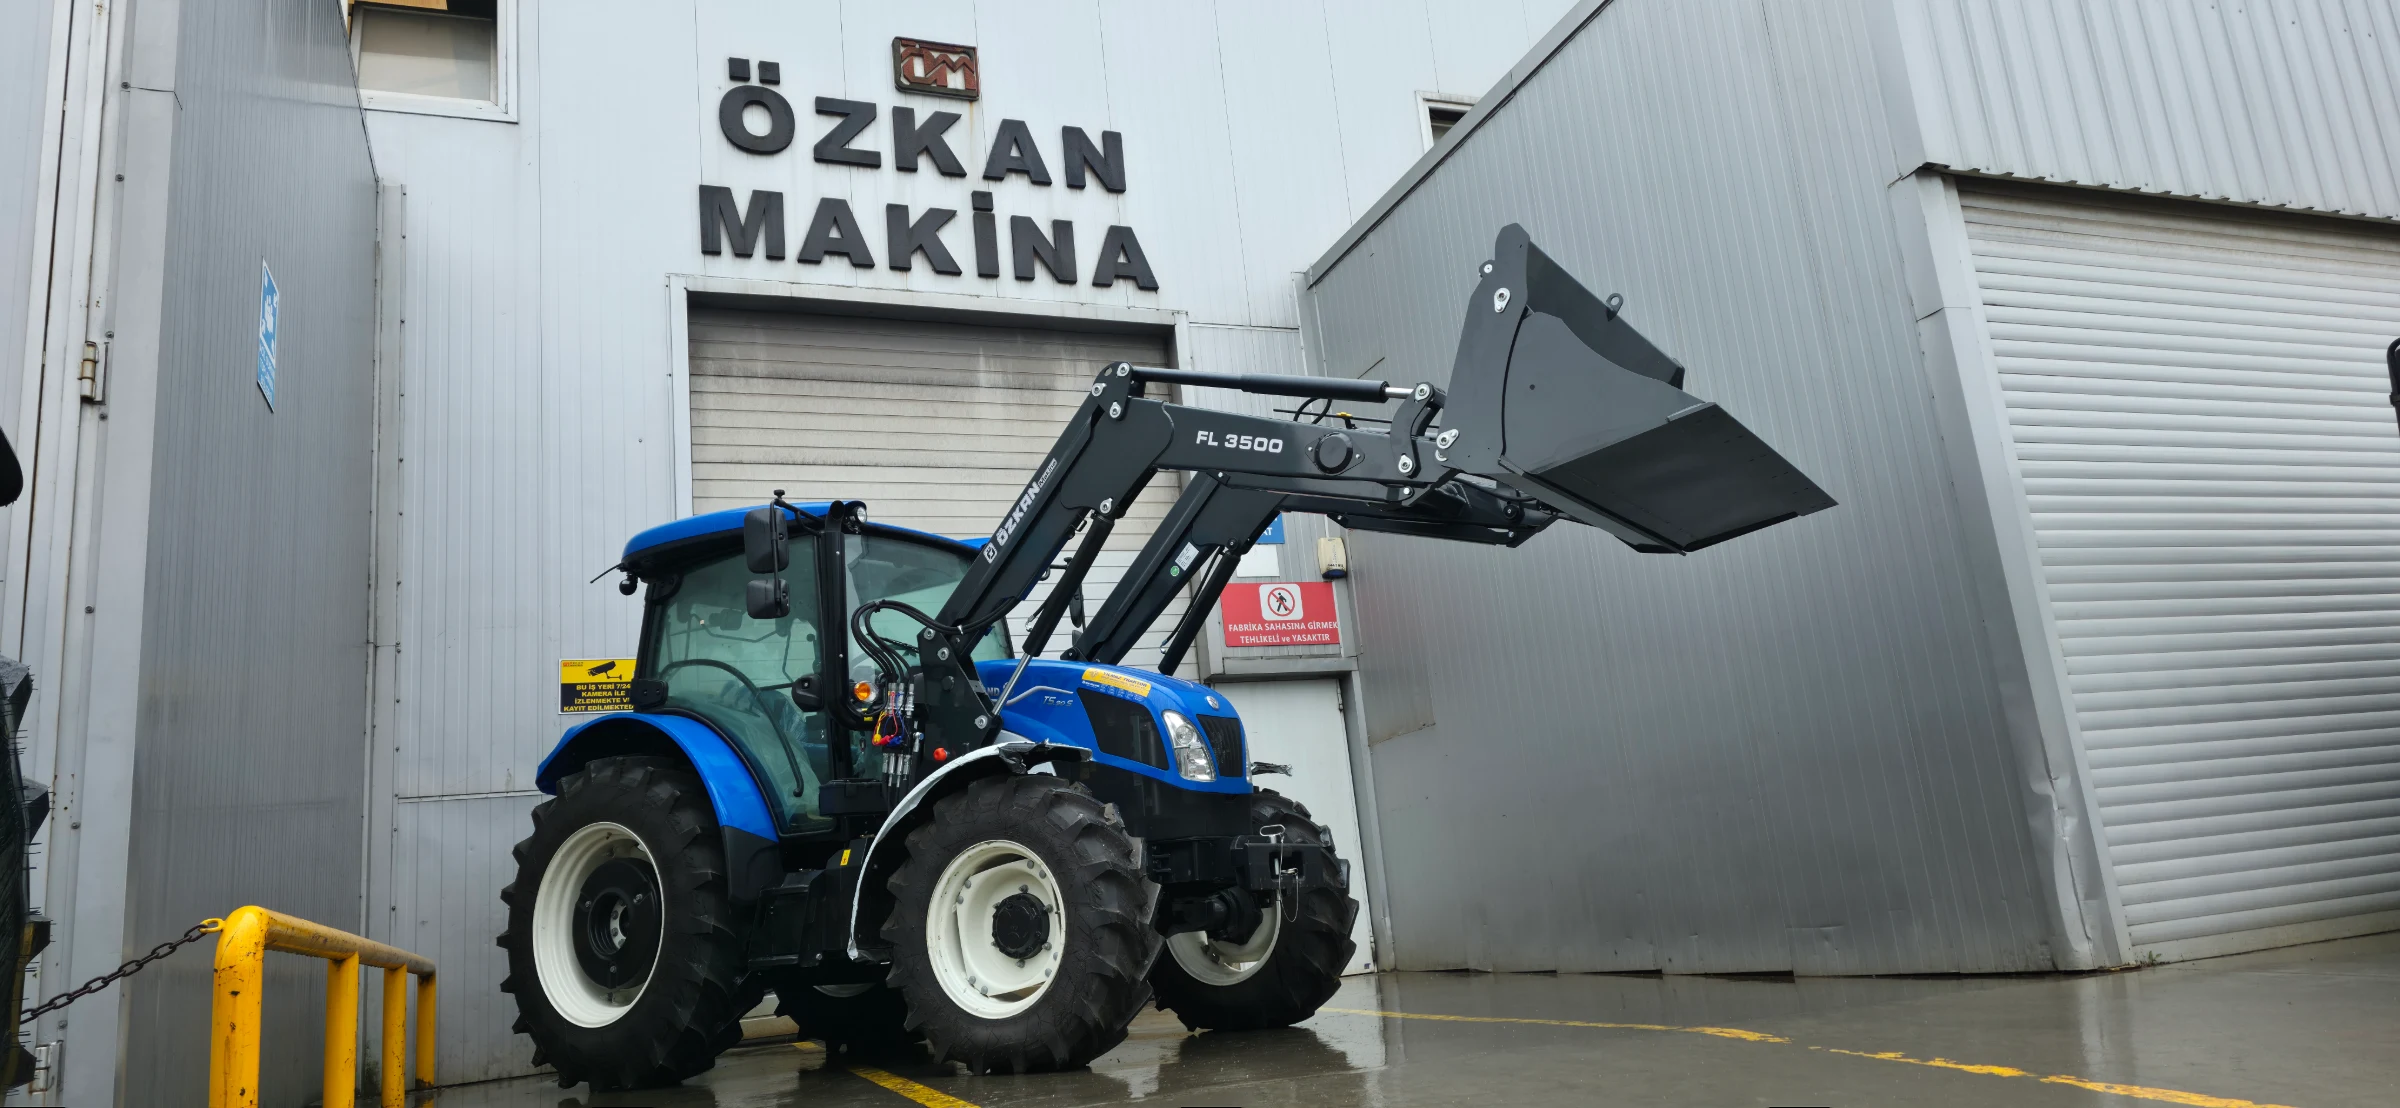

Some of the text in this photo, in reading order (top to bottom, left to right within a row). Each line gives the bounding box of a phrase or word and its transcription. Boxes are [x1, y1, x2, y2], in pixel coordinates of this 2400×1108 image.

[719, 57, 1126, 193] ÖZKAN
[699, 184, 1159, 291] MAKİNA
[1196, 430, 1284, 453] FL 3500
[996, 481, 1041, 547] ÖZKAN
[1228, 621, 1339, 632] FABRİKA SAHASINA GİRMEK
[1240, 634, 1280, 644] TEHLİKELİ
[1292, 633, 1331, 642] YASAKTIR
